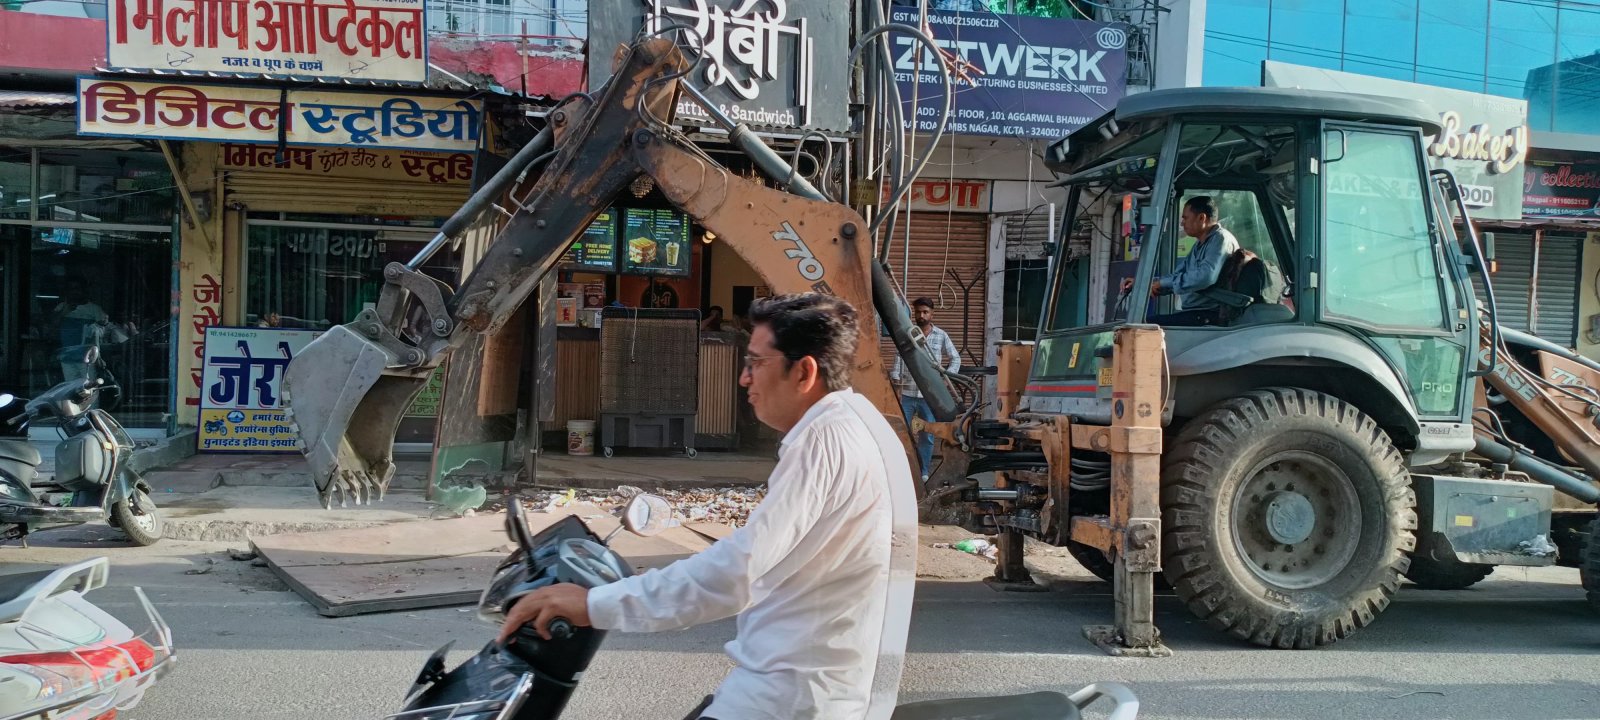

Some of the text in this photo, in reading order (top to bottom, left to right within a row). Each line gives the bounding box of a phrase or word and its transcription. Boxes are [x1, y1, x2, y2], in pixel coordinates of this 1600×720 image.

[893, 12, 909, 22] GST
[895, 36, 1107, 82] ZETWERK
[1017, 81, 1073, 93] BUSINESSES
[1074, 83, 1108, 95] LIMITED
[82, 82, 480, 144] डिजिटल स्टूडियो
[731, 105, 795, 126] Sandwich
[916, 106, 936, 116] ADD
[1007, 111, 1055, 123] AGGARWAL
[948, 122, 967, 132] MBS
[1031, 126, 1060, 137] 324002
[1434, 110, 1528, 174] Bakery
[770, 220, 825, 281] 770
[1478, 347, 1539, 402] CASE
[1421, 381, 1453, 393] PRO
